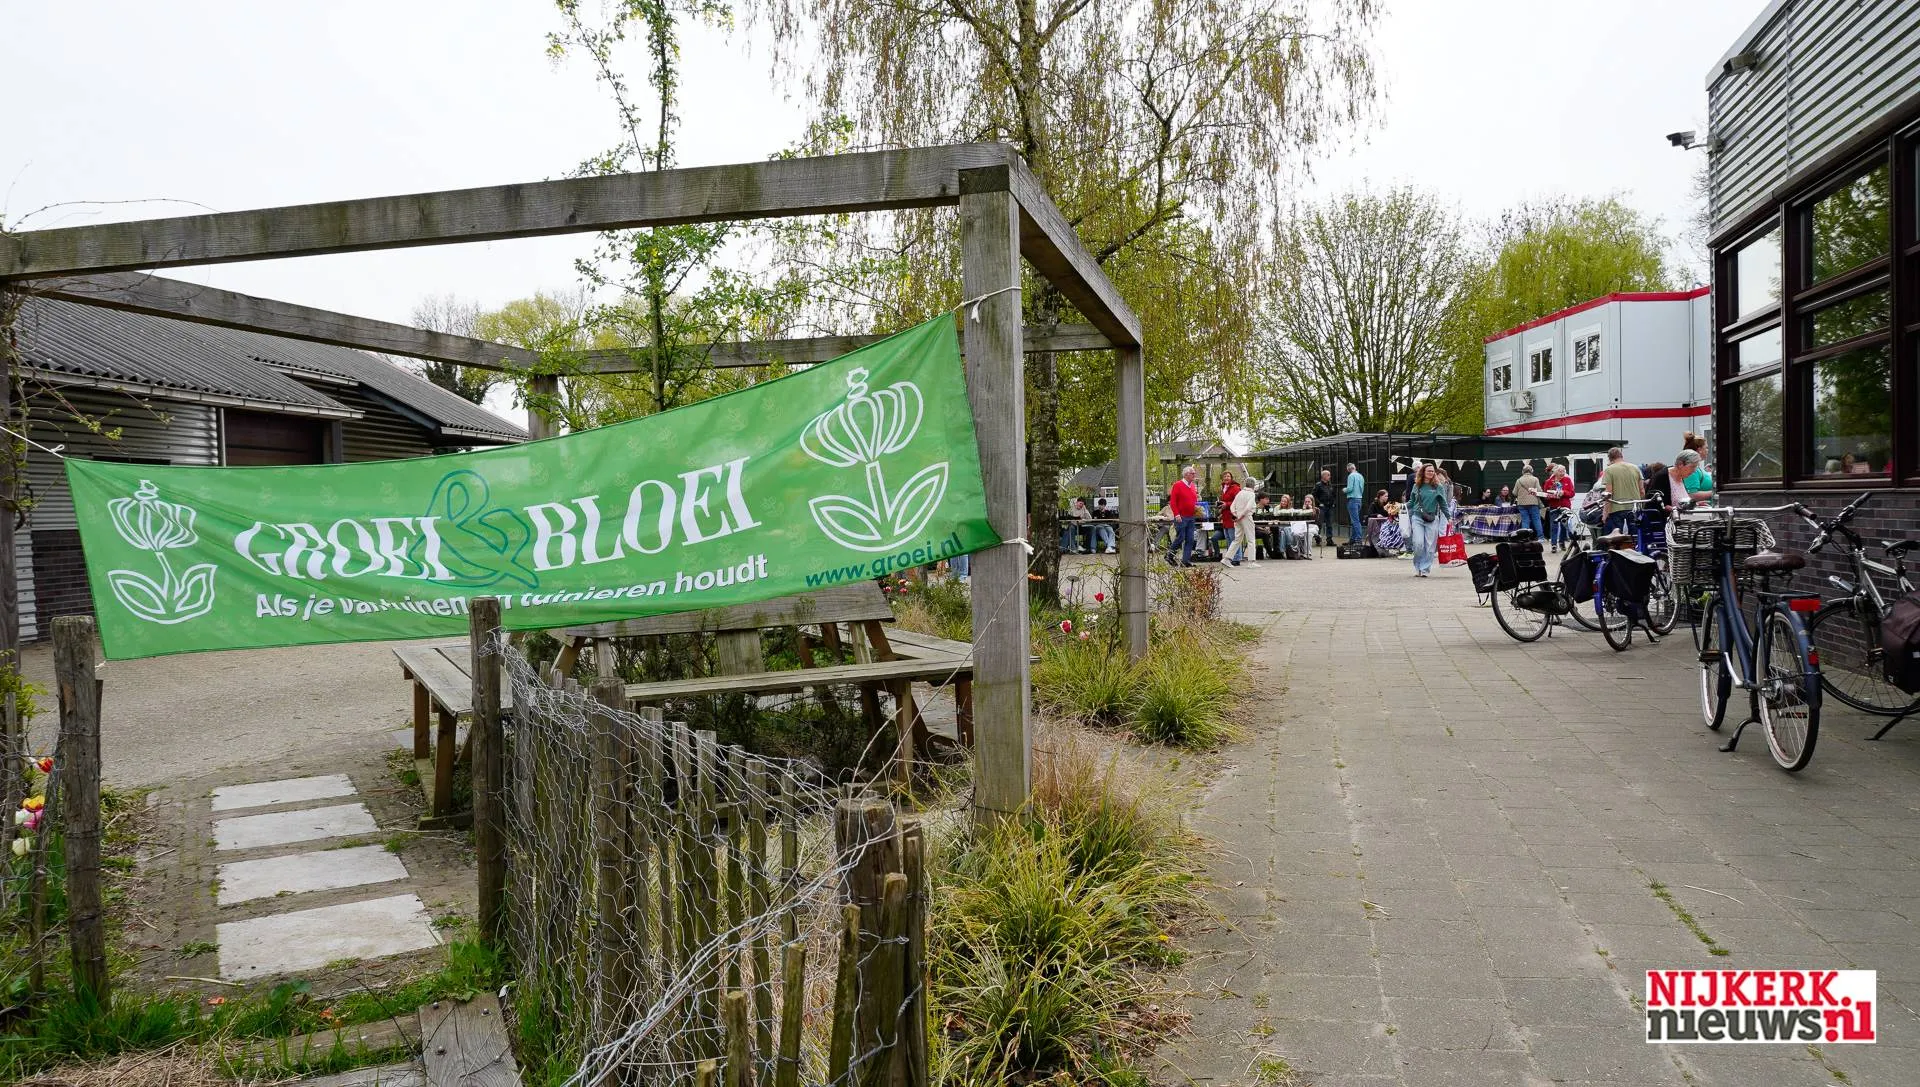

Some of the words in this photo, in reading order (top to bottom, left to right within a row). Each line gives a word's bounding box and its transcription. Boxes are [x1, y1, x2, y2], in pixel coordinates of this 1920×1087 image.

[234, 516, 456, 582] GROEI
[407, 469, 539, 589] &
[523, 456, 762, 572] BLOEI
[256, 593, 299, 618] Als
[302, 593, 335, 621] je
[520, 579, 667, 608] tuinieren
[673, 552, 769, 594] houdt
[806, 532, 964, 587] www.groei.nl
